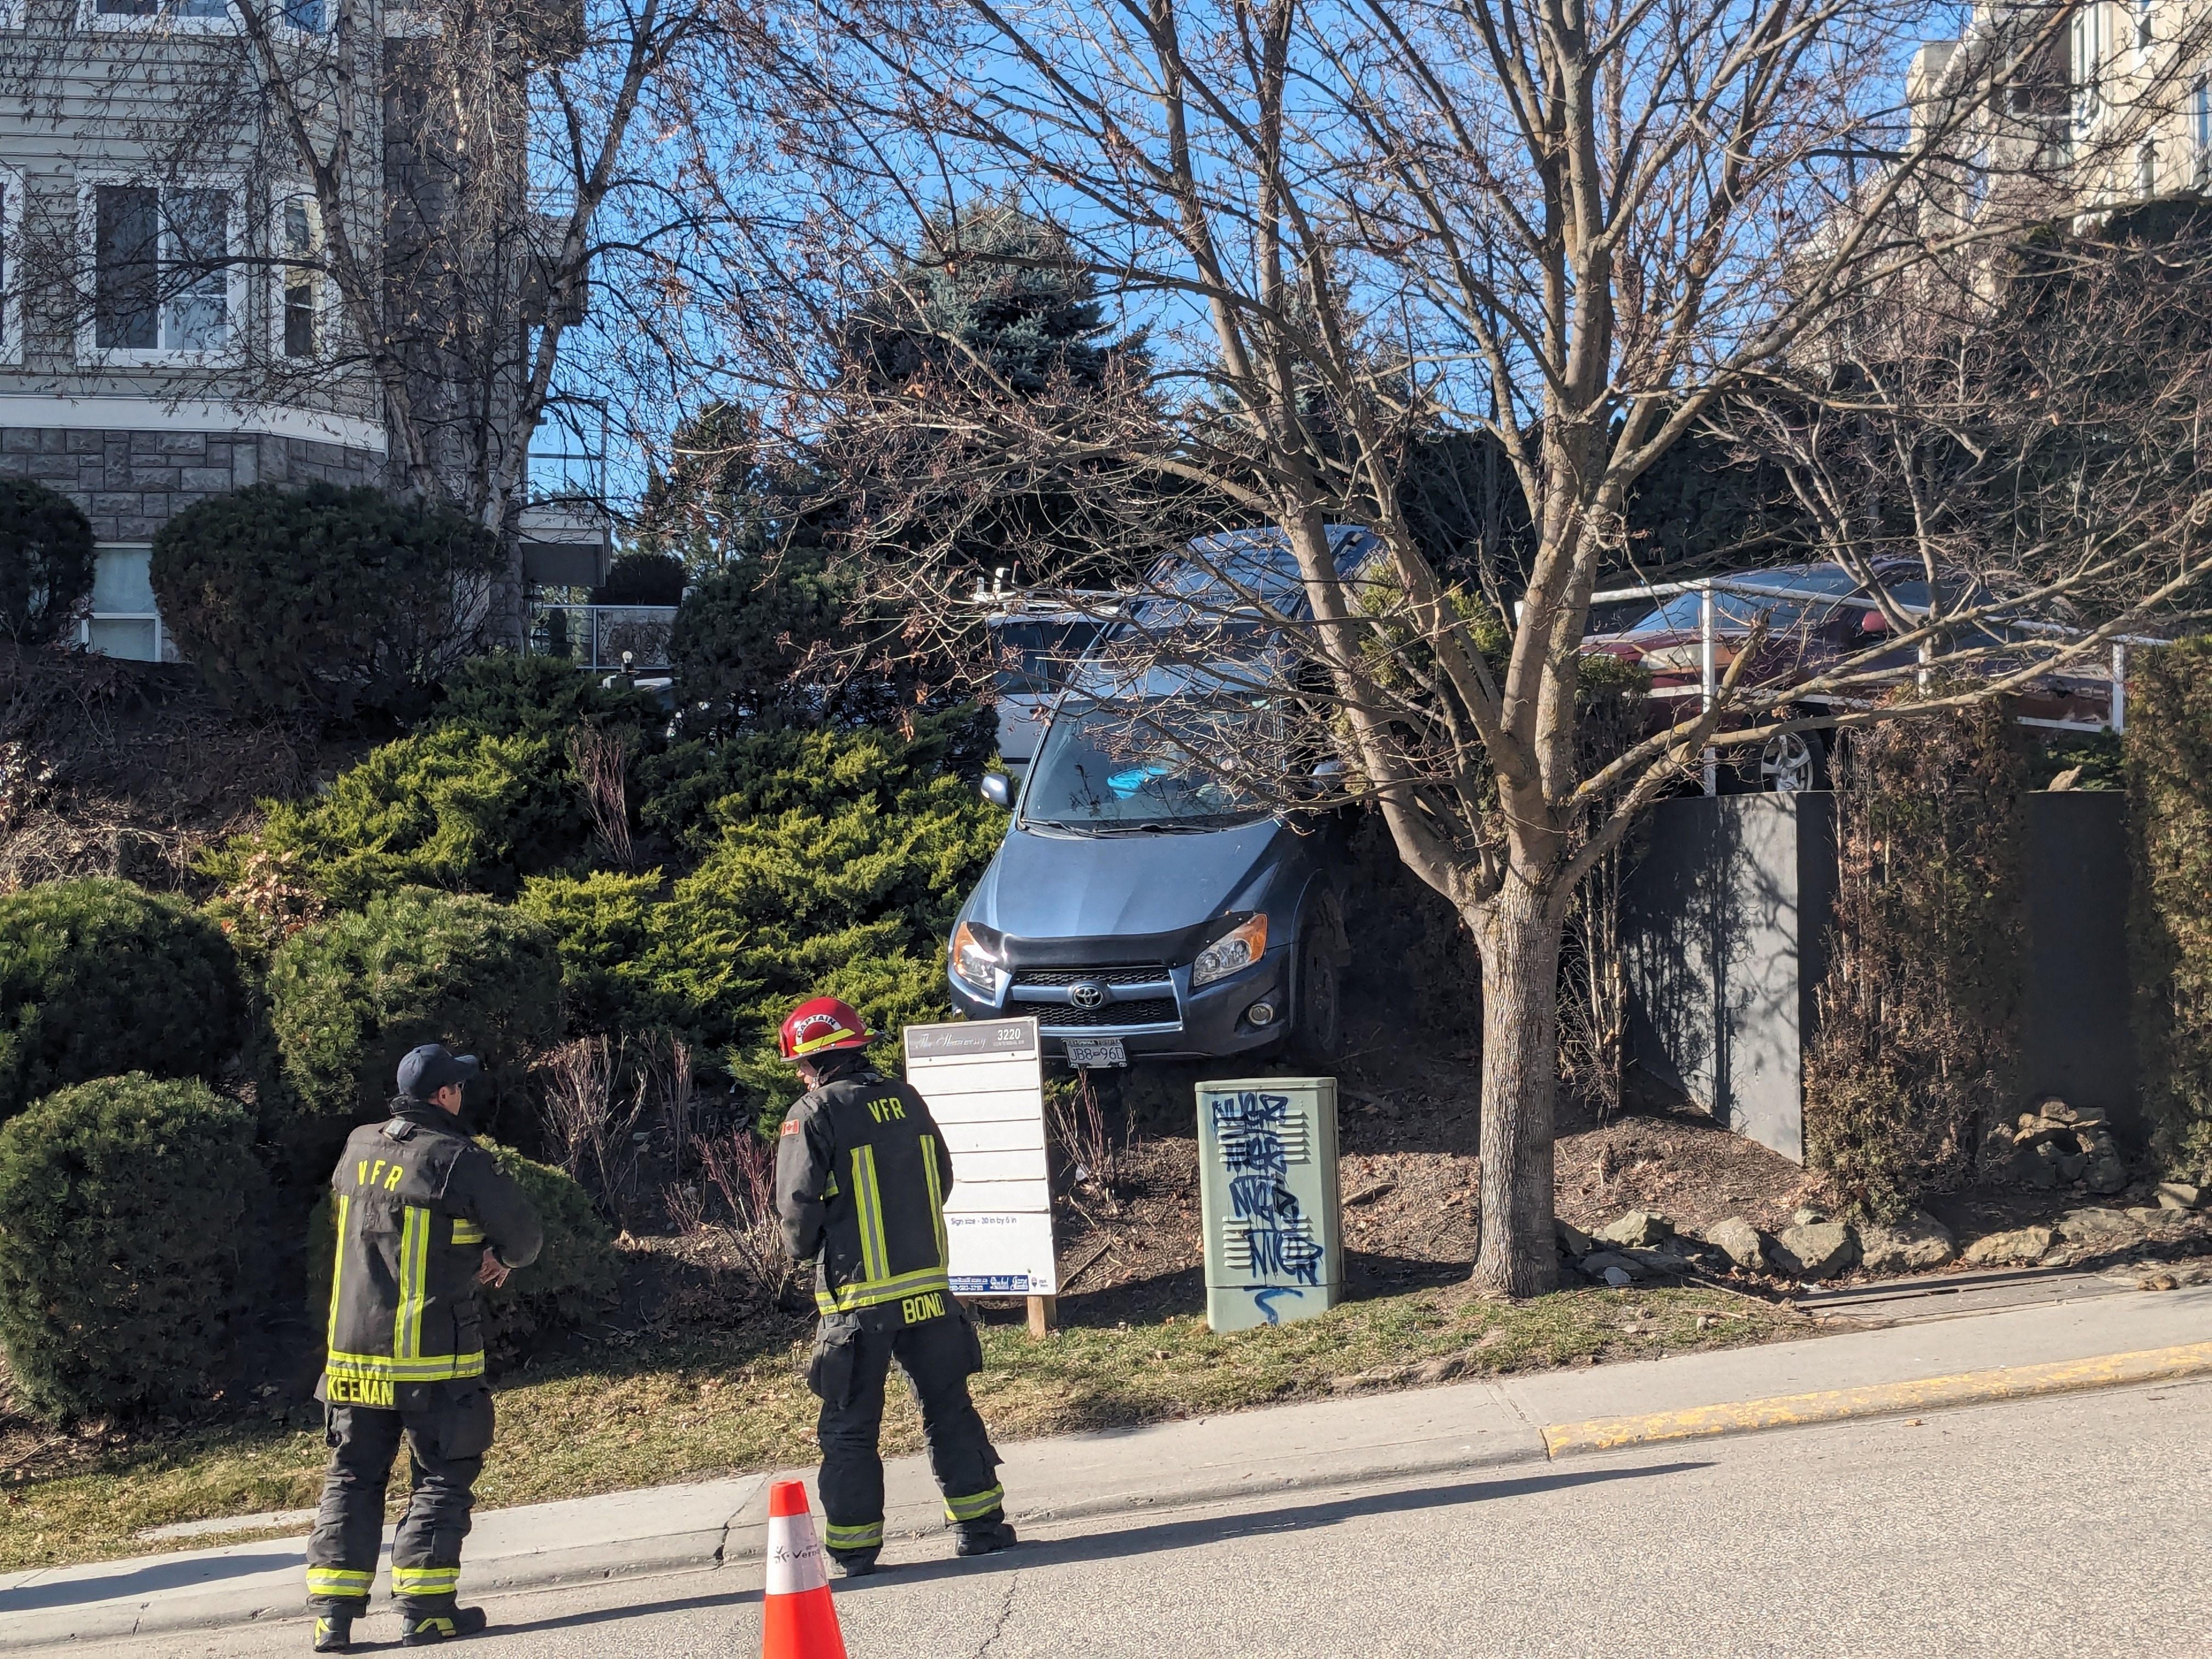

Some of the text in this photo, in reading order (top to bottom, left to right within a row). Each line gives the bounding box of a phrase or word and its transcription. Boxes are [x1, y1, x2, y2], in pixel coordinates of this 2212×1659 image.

[797, 1015, 836, 1038] CAPTAIN
[997, 1028, 1021, 1041] 3220
[867, 1098, 906, 1123] VFR
[359, 1160, 403, 1191] VFR
[902, 1292, 945, 1324] BOND
[327, 1375, 394, 1406] KEENAN
